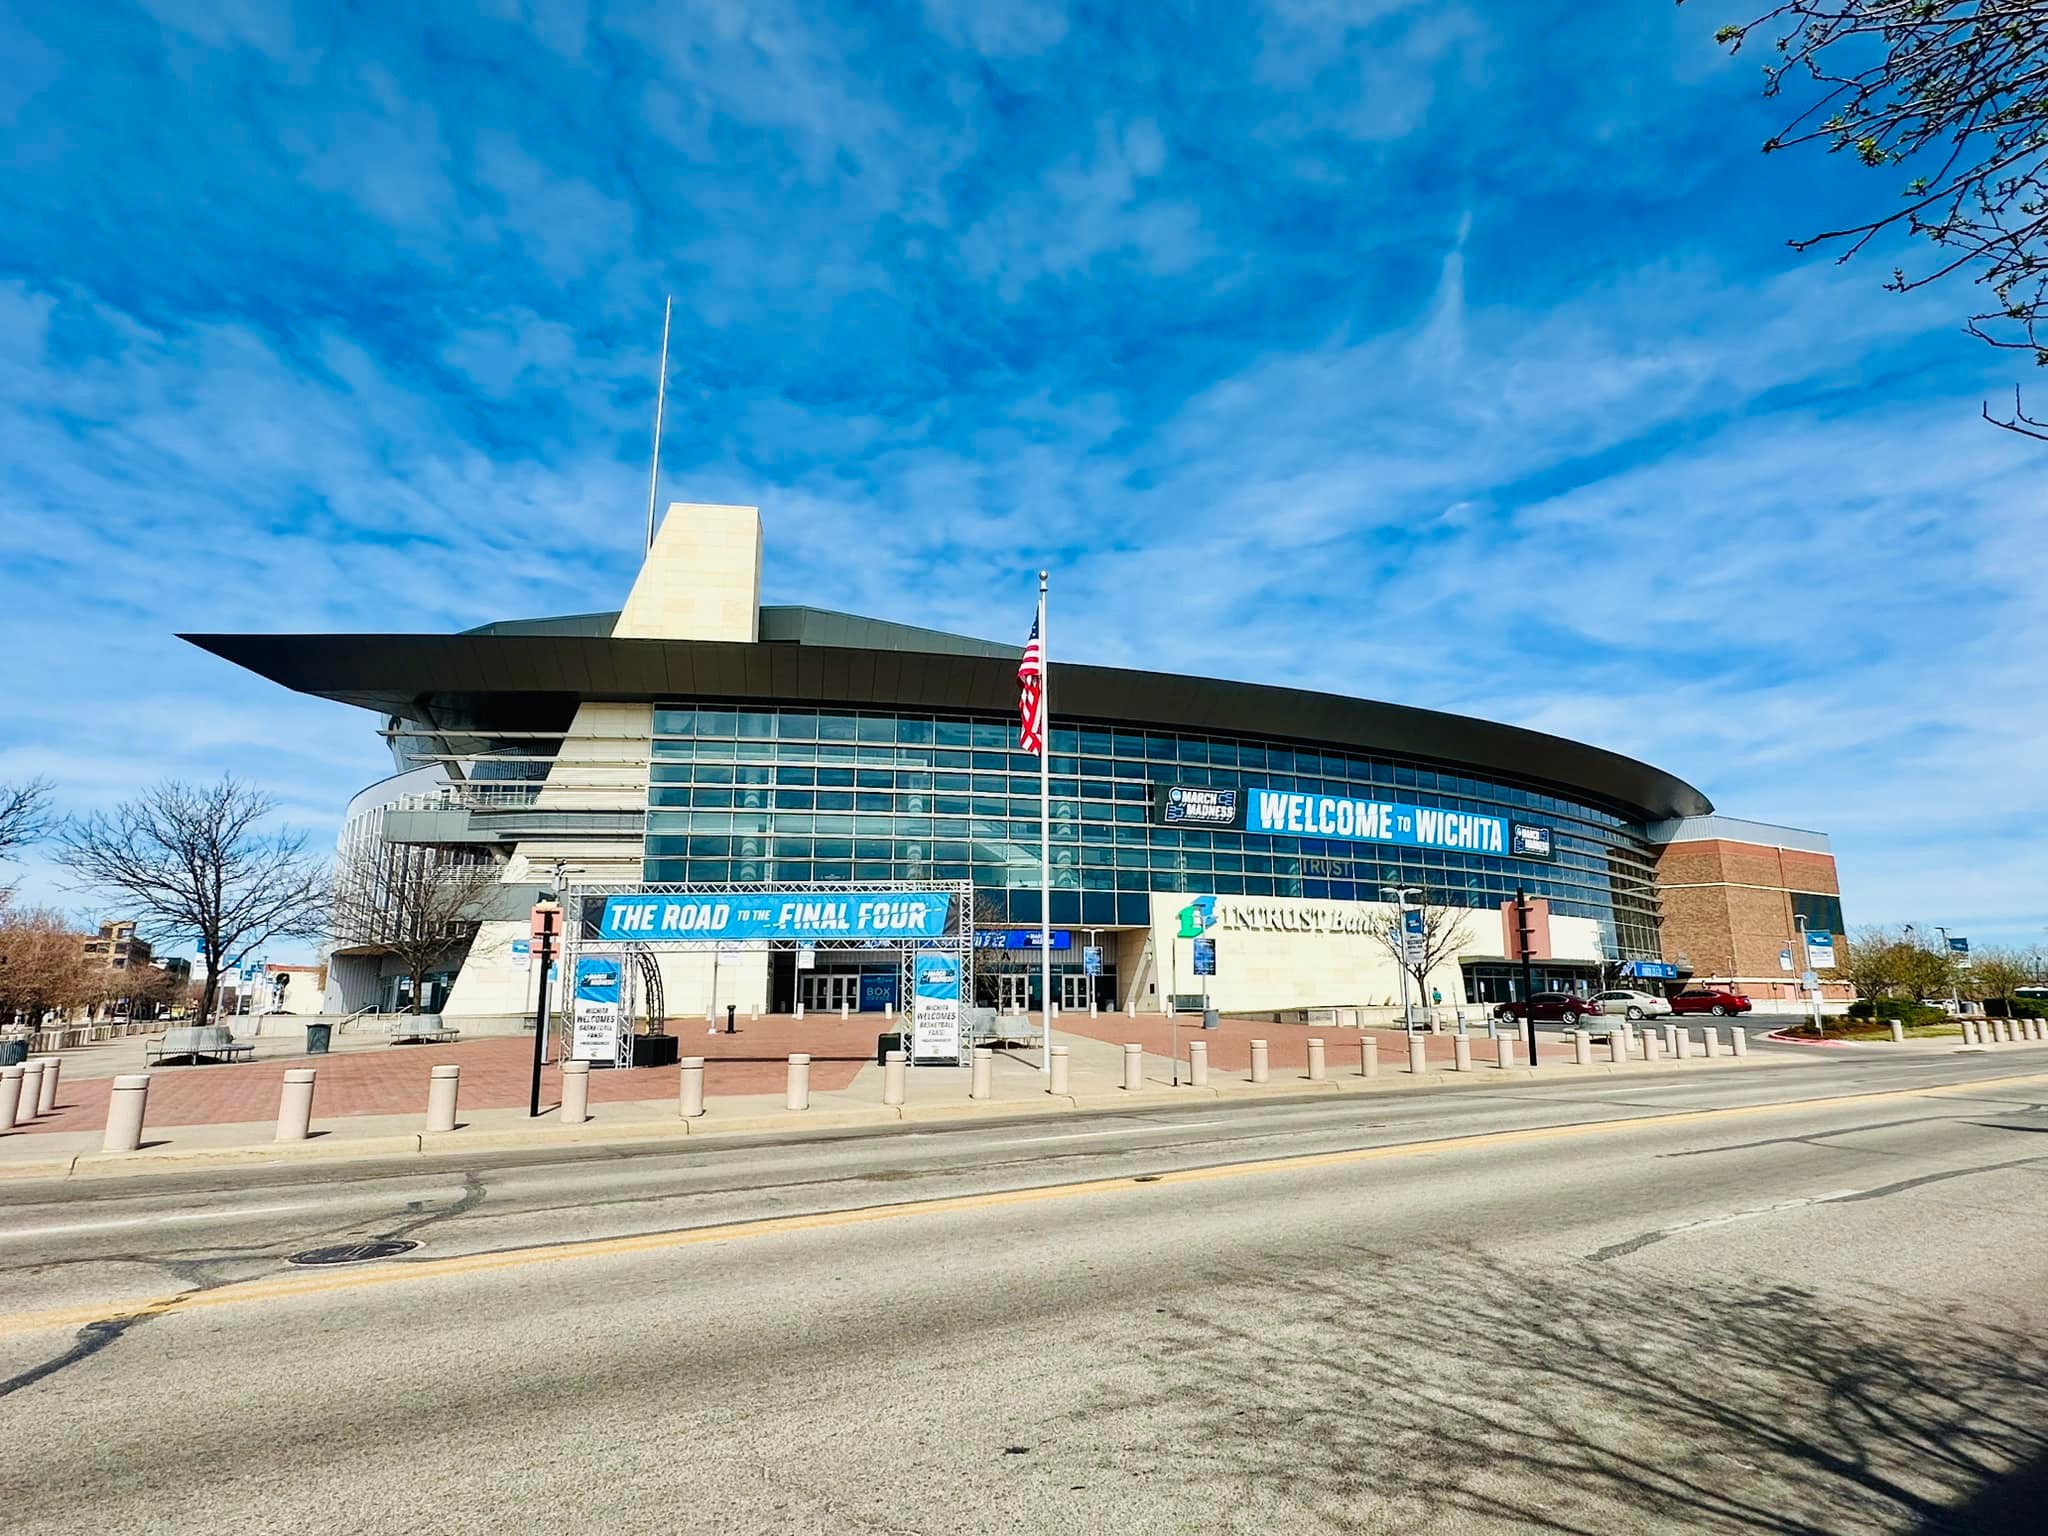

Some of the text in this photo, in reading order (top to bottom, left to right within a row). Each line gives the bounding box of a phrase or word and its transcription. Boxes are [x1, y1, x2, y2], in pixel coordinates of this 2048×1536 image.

[1182, 791, 1218, 804] MARCH
[1186, 804, 1234, 818] MADNESS
[1260, 792, 1503, 852] WELCOME TO WICHITA
[1303, 859, 1351, 877] TRUST
[611, 902, 927, 931] THE ROAD TO THE FINAL FOUR
[1222, 904, 1328, 934] INTRUST
[866, 987, 890, 997] BOX
[577, 1015, 616, 1024] WELCOMES
[917, 1012, 957, 1020] WELCOMES
